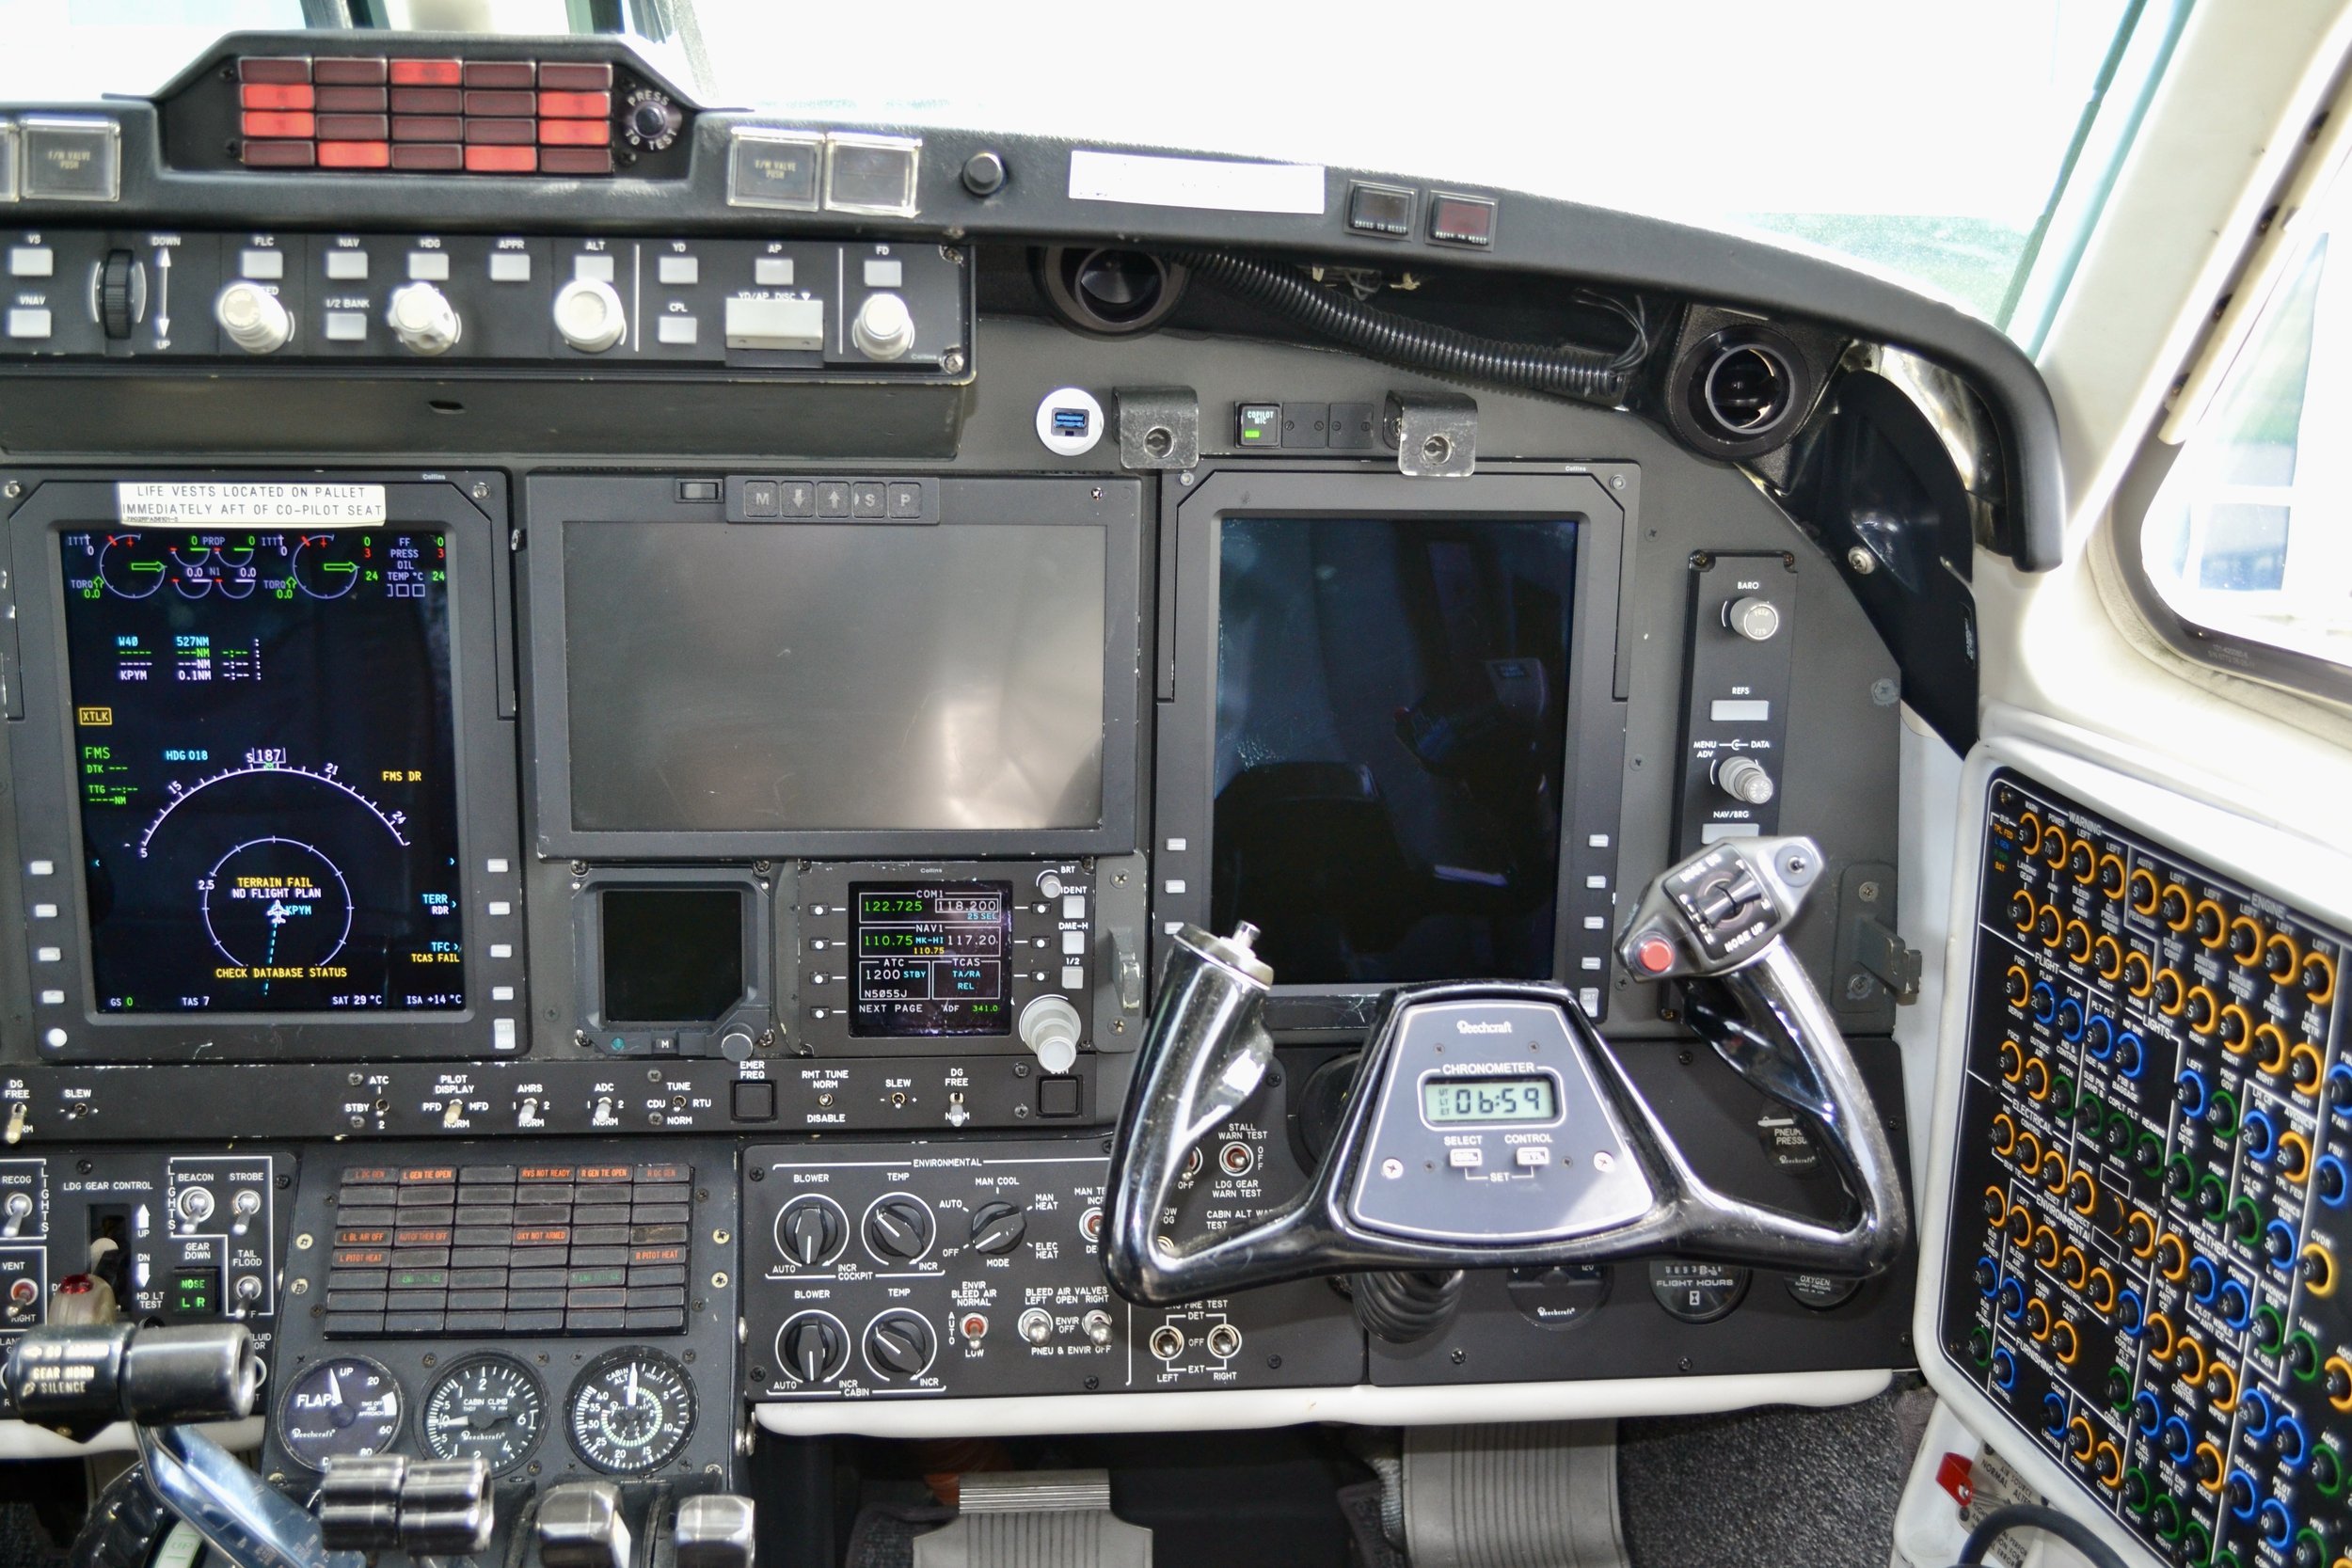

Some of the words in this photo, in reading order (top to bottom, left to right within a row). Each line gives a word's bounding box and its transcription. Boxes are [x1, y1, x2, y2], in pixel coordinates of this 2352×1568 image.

[628, 90, 670, 107] PRESS
[626, 128, 642, 147] TO
[647, 128, 678, 150] TEST
[152, 236, 181, 246] DOWN
[254, 237, 275, 246] FLC
[339, 238, 360, 247] NAV
[421, 238, 441, 249] HDG
[499, 240, 525, 250] APPR
[585, 241, 605, 251] ALT
[20, 295, 46, 306] VNAV
[326, 298, 341, 309] 1/2
[342, 298, 370, 309] BANK
[669, 302, 688, 313] CPL
[137, 485, 164, 498] LIFE
[172, 486, 216, 498] VESTS
[224, 486, 284, 498] LOCATED
[292, 487, 308, 498] ON
[315, 487, 365, 499] PALLET
[122, 504, 212, 515] IMMEDIATELY
[222, 504, 246, 515] AFT
[253, 504, 270, 515] OF
[277, 504, 341, 515] CO-PILOT
[348, 505, 381, 515] SEAT
[390, 549, 419, 559] PRESS
[397, 561, 414, 570] OIL
[388, 572, 410, 581] TEMP
[176, 637, 209, 646] 527NM
[120, 671, 147, 680] KPYM
[178, 671, 212, 681] 0.1NM
[1732, 687, 1749, 695] REFS
[83, 711, 109, 722] XTLK
[1751, 740, 1770, 749] DATA
[86, 748, 110, 759] FMS
[167, 752, 186, 760] HDG
[188, 751, 208, 760] 018
[383, 771, 404, 781] FMS
[408, 771, 421, 781] DR
[2069, 811, 2103, 836] WARNING
[237, 878, 282, 887] TERRAIN
[288, 878, 312, 887] FAIL
[232, 888, 246, 898] NO
[252, 888, 289, 898] FLIGHT
[294, 888, 321, 898] PLAN
[916, 890, 943, 898] COM1
[422, 895, 448, 904] TERR
[865, 902, 923, 911] 122.725
[938, 901, 996, 911] 118.200
[2251, 893, 2285, 918] ENGINE
[1058, 922, 1089, 930] DME-H
[865, 936, 913, 946] 110.75
[411, 954, 434, 962] TCAS
[438, 954, 460, 962] FAIL
[2034, 952, 2059, 974] FLIGHT
[215, 969, 248, 978] CHECK
[254, 968, 304, 978] DATABASE
[310, 968, 347, 978] STATUS
[866, 970, 900, 979] 1200
[2142, 1017, 2171, 1038] LIGHTS
[739, 1061, 765, 1070] EMER
[1442, 1062, 1534, 1074] CHRONOMETER
[739, 1070, 765, 1080] FREQ
[802, 1070, 820, 1079] RMT
[825, 1070, 849, 1079] TUNE
[370, 1076, 389, 1085] ATC
[440, 1075, 468, 1084] PILOT
[885, 1079, 911, 1087] SLEW
[945, 1078, 969, 1086] FREE
[517, 1084, 543, 1093] AHRS
[595, 1084, 614, 1092] ADC
[667, 1083, 691, 1091] TUNE
[813, 1080, 838, 1089] NORM
[5, 1089, 30, 1099] FREE
[65, 1089, 91, 1098] SLEW
[435, 1085, 474, 1094] DISPLAY
[345, 1103, 370, 1113] STBY
[423, 1102, 442, 1111] PFD
[469, 1102, 489, 1111] MFD
[667, 1116, 692, 1125] NORM
[807, 1114, 845, 1123] DISABLE
[2012, 1098, 2052, 1134] ELECTRICAL
[1230, 1123, 1256, 1132] STALL
[1218, 1132, 1244, 1140] WARN
[1444, 1135, 1482, 1145] SELECT
[1504, 1133, 1553, 1144] CONTROL
[914, 1158, 982, 1167] ENVIRONMENTAL
[2, 1176, 31, 1184] RECOG
[230, 1173, 263, 1181] STROBE
[793, 1174, 829, 1183] BLOWER
[887, 1172, 910, 1181] TEMP
[1490, 1172, 1510, 1182] SET
[64, 1182, 82, 1191] LDG
[113, 1181, 153, 1190] CONTROL
[976, 1178, 993, 1186] MAN
[995, 1177, 1019, 1186] COOL
[1216, 1180, 1233, 1189] LDG
[1236, 1180, 1259, 1188] GEAR
[1243, 1189, 1262, 1197] TEST
[1036, 1194, 1054, 1202] MAN
[940, 1199, 962, 1209] AUTO
[1036, 1201, 1057, 1211] HEAT
[1207, 1210, 1232, 1218] CABIN
[1235, 1210, 1251, 1218] ALT
[2188, 1223, 2228, 1259] WEATHER
[186, 1243, 210, 1251] GEAR
[233, 1259, 262, 1267] FLOOD
[986, 1259, 1009, 1267] MODE
[772, 1265, 796, 1274] AUTO
[838, 1271, 873, 1280] COCKPIT
[182, 1280, 205, 1289] NOSE
[1696, 1278, 1733, 1287] HOURS
[1800, 1275, 1831, 1286] OXYGEN
[794, 1290, 831, 1299] BLOWER
[888, 1288, 911, 1297] TEMP
[1025, 1287, 1054, 1296] BLEED
[1057, 1287, 1072, 1295] AIR
[1075, 1286, 1107, 1295] VALVES
[957, 1297, 992, 1307] NORMAL
[2016, 1337, 2054, 1376] FURNISHING
[1214, 1372, 1237, 1381] RIGHT
[844, 1386, 869, 1397] CABIN
